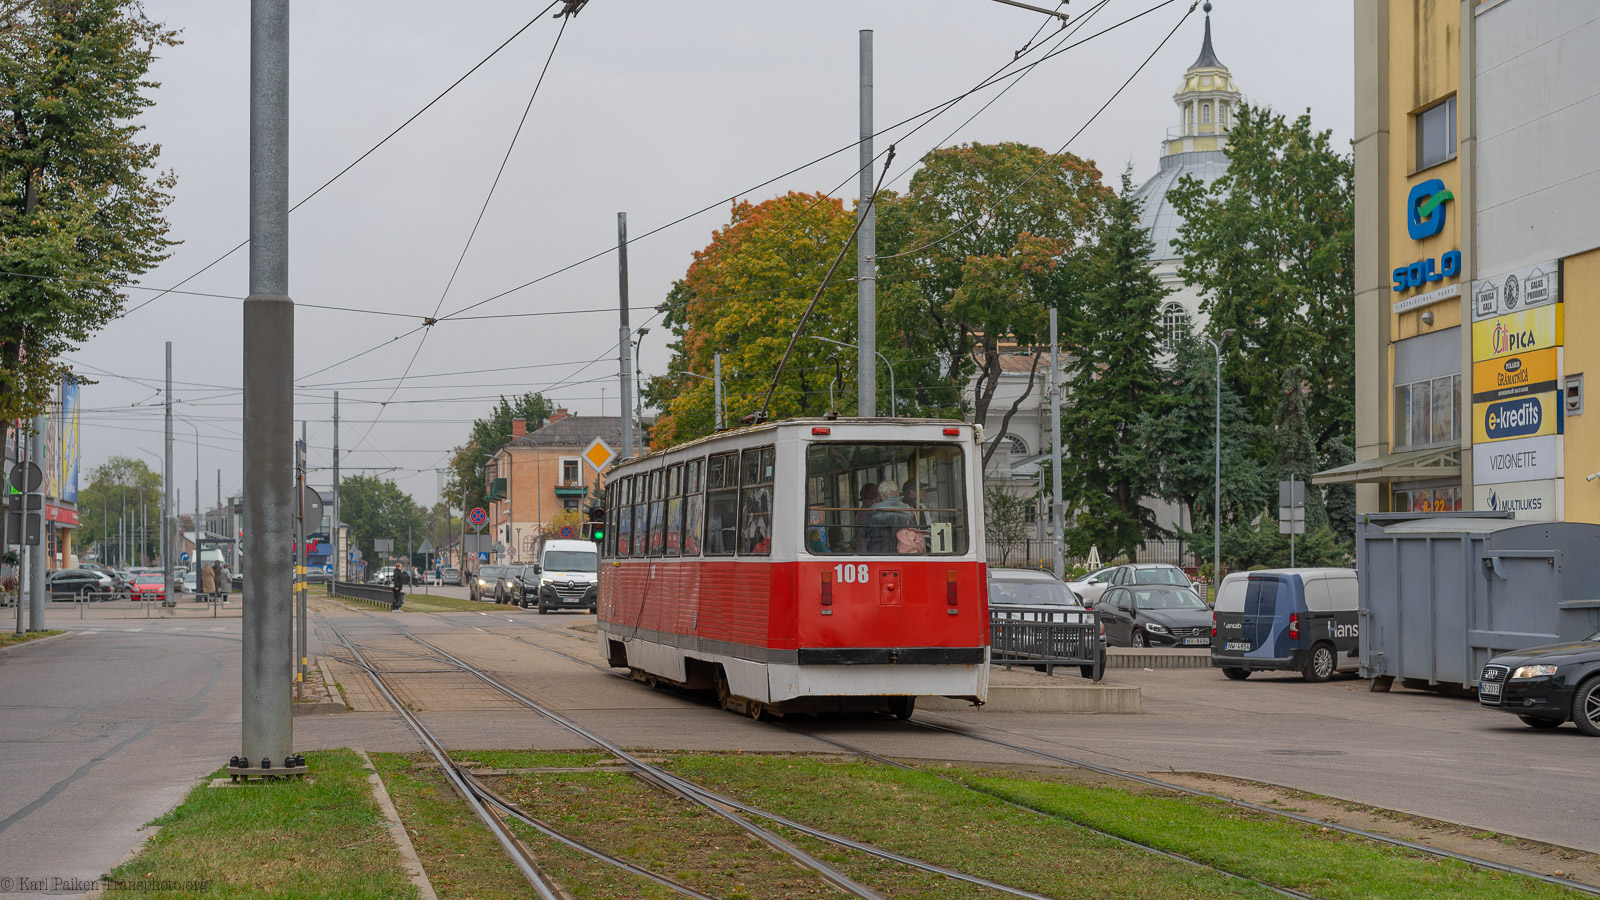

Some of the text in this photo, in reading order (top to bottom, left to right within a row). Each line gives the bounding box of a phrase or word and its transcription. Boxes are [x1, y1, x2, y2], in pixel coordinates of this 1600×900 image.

[1393, 250, 1461, 292] SOLO
[1480, 292, 1495, 302] SVAIGA
[1526, 288, 1547, 300] PRODUKTI
[1509, 329, 1536, 351] PICA
[1488, 402, 1539, 431] e-kredits
[1489, 451, 1537, 471] VIZIONETTE
[1501, 497, 1542, 512] MULTILUKSS
[936, 528, 946, 552] 1
[834, 563, 869, 584] 108
